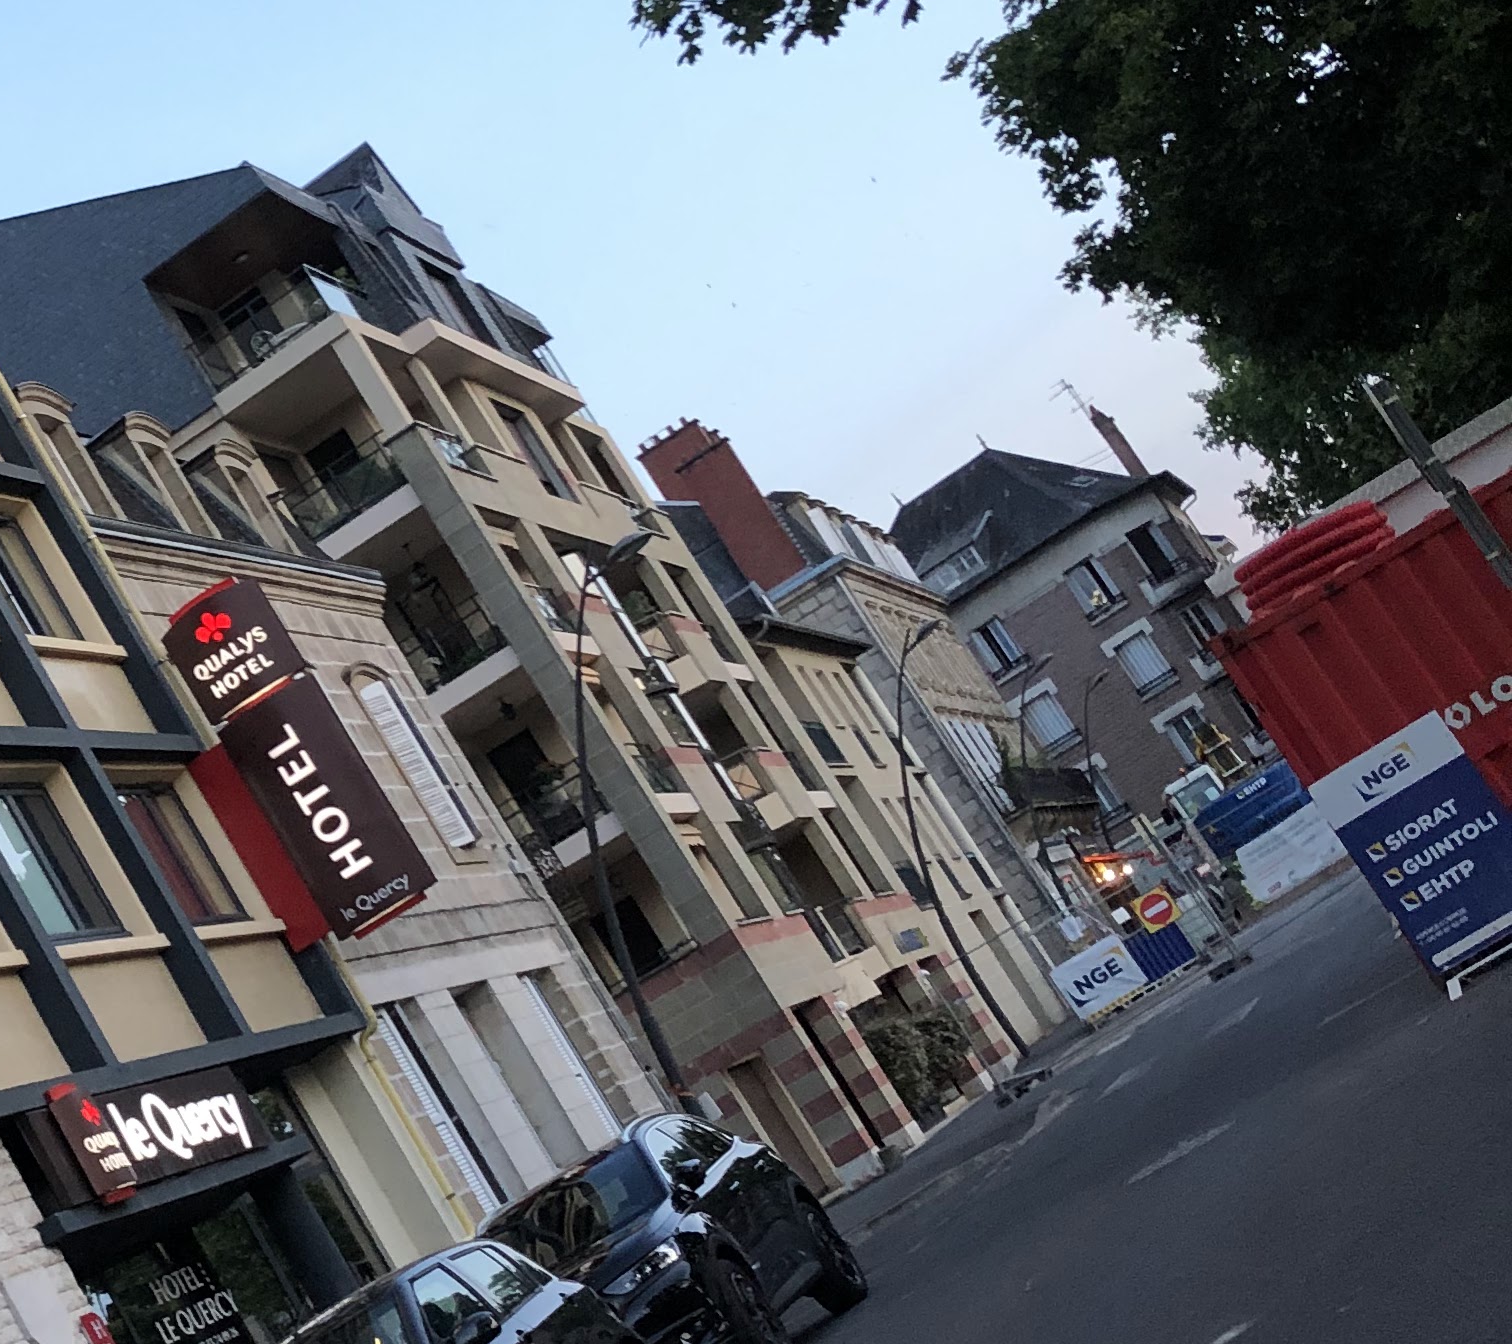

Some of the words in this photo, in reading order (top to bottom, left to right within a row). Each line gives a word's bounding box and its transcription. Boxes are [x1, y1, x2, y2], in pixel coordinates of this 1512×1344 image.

[193, 626, 267, 681] QUALYS
[210, 653, 275, 699] HOTEL
[1361, 753, 1411, 790] NGE
[268, 723, 374, 879] HOTEL
[1384, 798, 1458, 852] SIORAT
[1402, 810, 1499, 875] GUINTOLI
[339, 907, 358, 922] le
[355, 874, 409, 911] Quercy
[1417, 859, 1475, 902] EHTP
[1073, 957, 1123, 995] NGE
[106, 1103, 158, 1161] le
[140, 1093, 253, 1159] Quercy
[155, 1317, 181, 1344] LE
[175, 1288, 239, 1335] QUERCY
